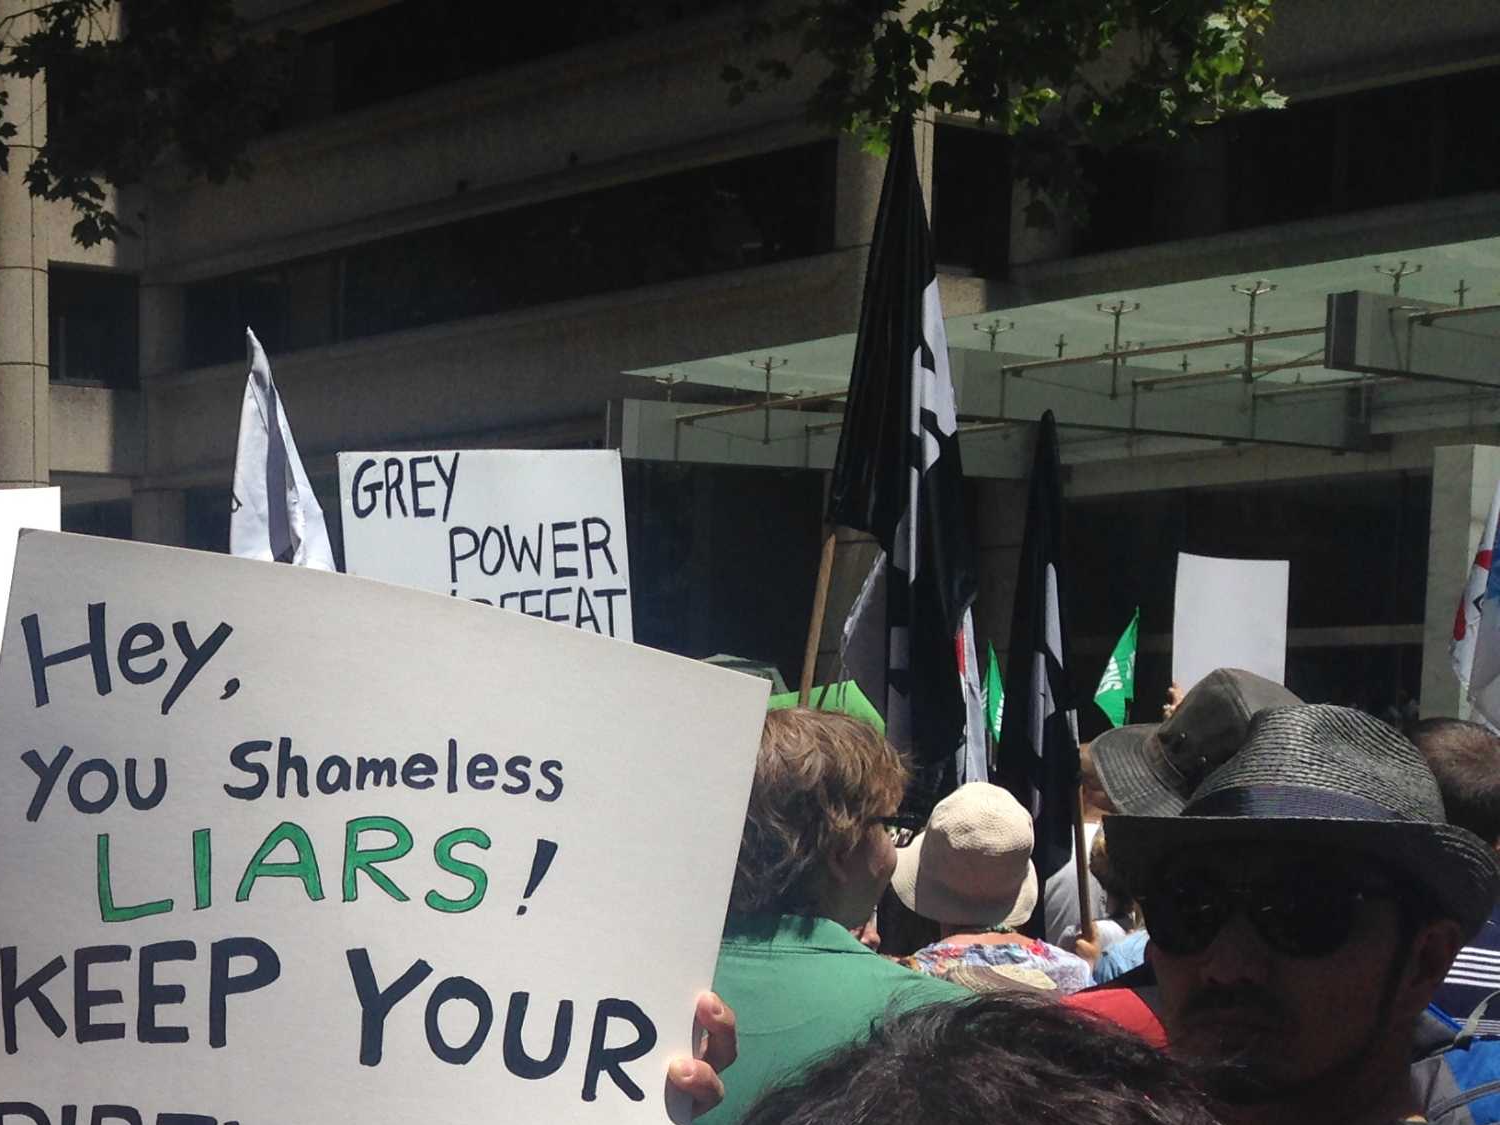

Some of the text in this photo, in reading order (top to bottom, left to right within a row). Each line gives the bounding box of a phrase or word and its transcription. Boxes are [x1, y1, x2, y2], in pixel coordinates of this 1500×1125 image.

[352, 453, 459, 522] GREY
[449, 517, 617, 583] POWER
[21, 602, 240, 715] Hey,
[20, 737, 563, 822] YOU Shameless
[0, 937, 657, 1101] KEEP YOUR
